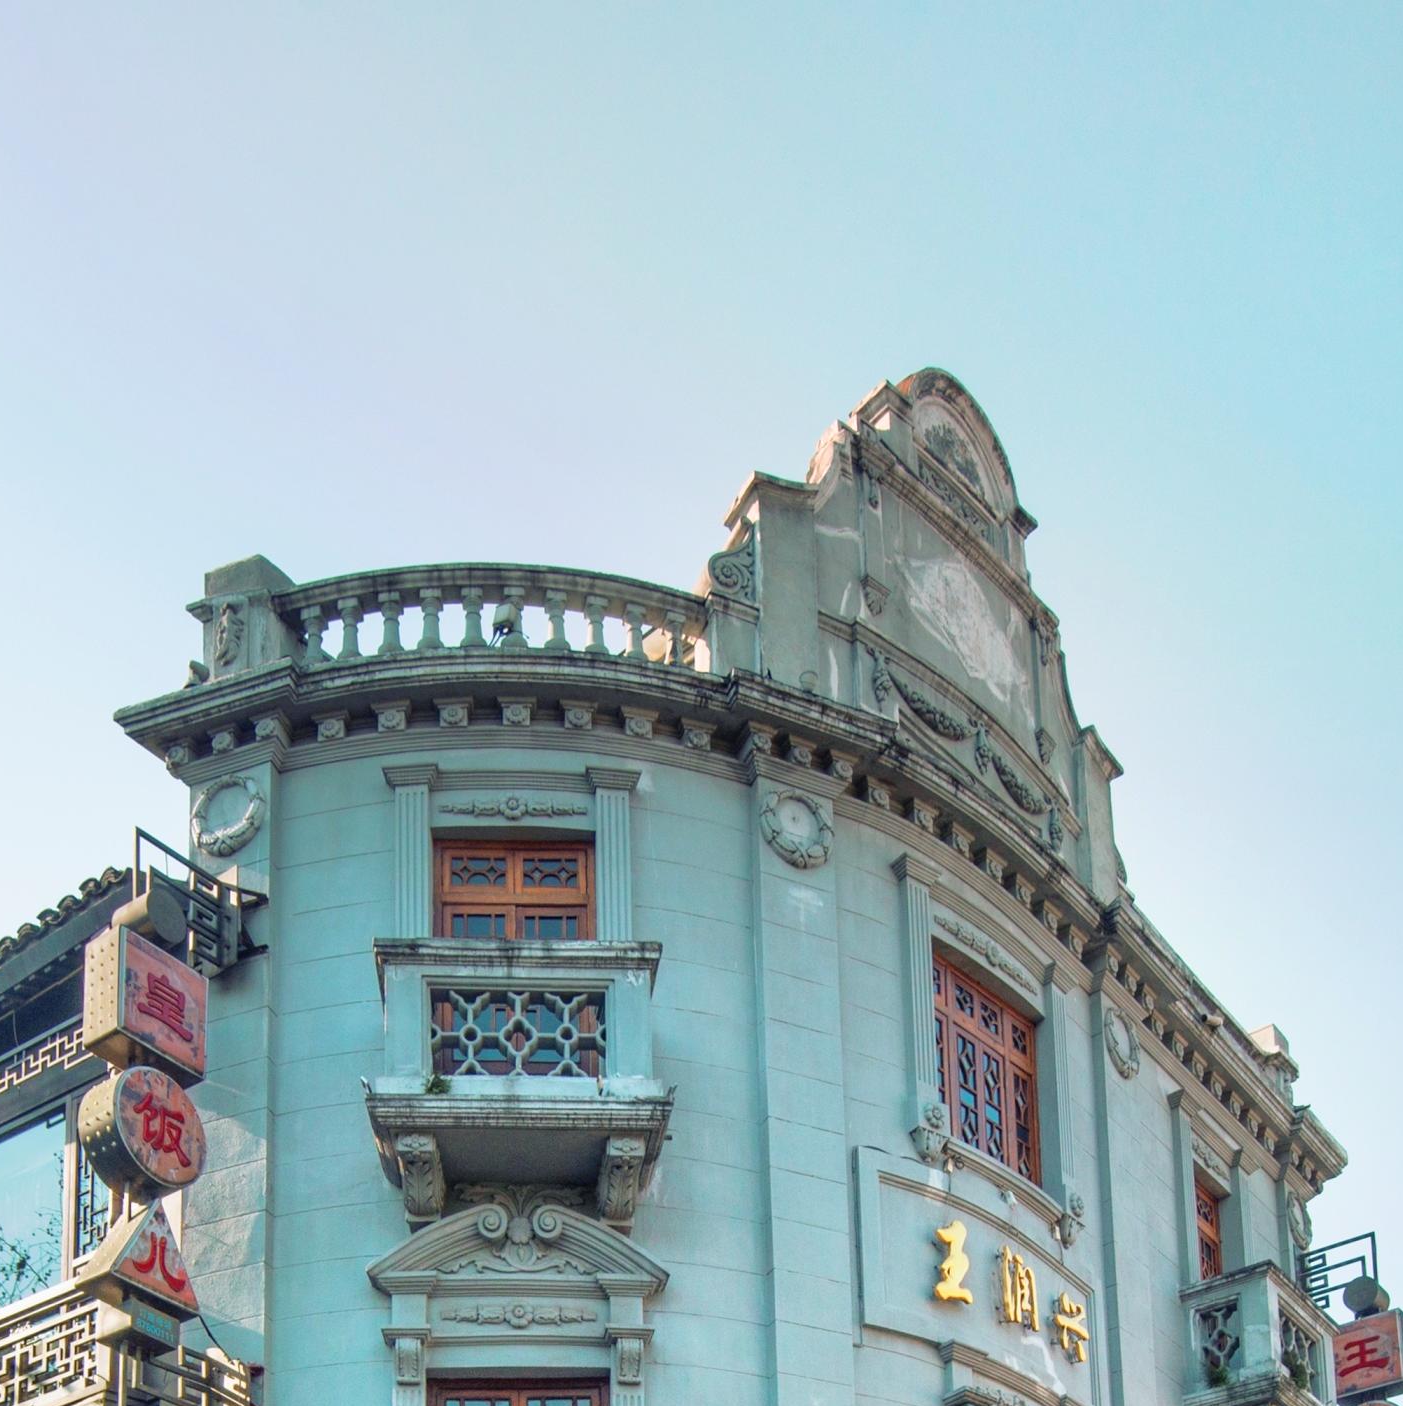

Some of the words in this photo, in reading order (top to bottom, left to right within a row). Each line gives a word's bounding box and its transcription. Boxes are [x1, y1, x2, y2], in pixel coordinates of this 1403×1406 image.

[132, 973, 193, 1292] 皇饭儿
[934, 1220, 1090, 1362] 王润兴
